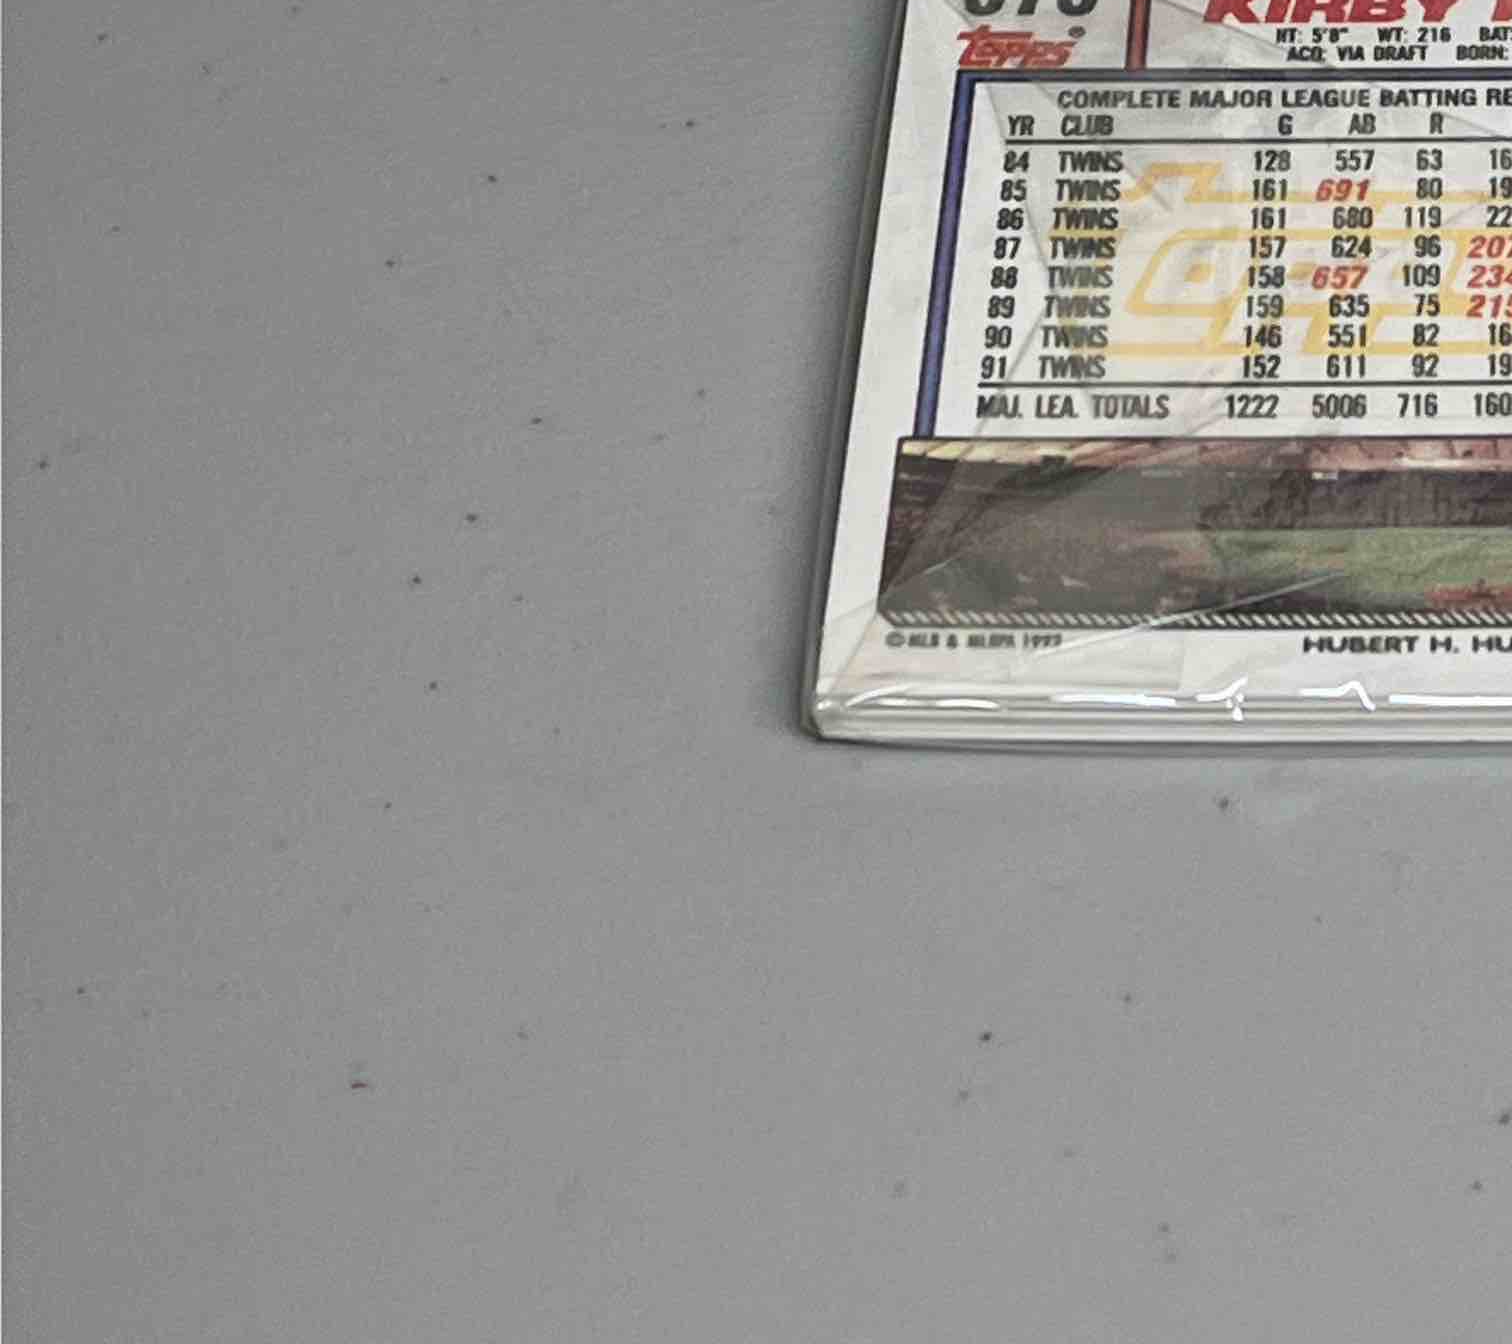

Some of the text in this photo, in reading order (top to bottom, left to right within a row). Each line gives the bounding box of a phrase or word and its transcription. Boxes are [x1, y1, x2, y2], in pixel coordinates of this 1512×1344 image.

[957, 23, 1077, 67] Topps
[1276, 27, 1303, 43] HT:
[1378, 27, 1408, 43] WT:
[1418, 27, 1451, 42] 216
[1287, 46, 1326, 62] ACQ:
[1337, 46, 1365, 61] VIA
[1373, 45, 1429, 62] DRAFT
[1456, 44, 1509, 61] BORN:
[1057, 90, 1181, 109] COMPLETE
[1189, 89, 1272, 108] MAJOR
[1281, 88, 1371, 107] LEAGUE
[1379, 88, 1477, 108] BATTING
[1008, 115, 1035, 136] YR
[1061, 114, 1114, 137] CLUB
[1278, 113, 1293, 136] G
[1348, 113, 1376, 135] AB
[1430, 111, 1445, 134] R
[1060, 150, 1125, 173] TWINS
[1254, 149, 1291, 172] 128
[1335, 149, 1375, 172] 557
[1416, 148, 1443, 171] 63
[1315, 179, 1370, 202] 691
[993, 236, 1022, 260] 87
[1049, 236, 1116, 260] TWINS
[1248, 234, 1287, 259] 157
[1331, 234, 1372, 261] 624
[1414, 234, 1442, 258] 96
[1311, 265, 1366, 289] 657
[981, 355, 1007, 381] 91
[1038, 355, 1105, 379] TWINS
[1243, 354, 1281, 379] 152
[1326, 353, 1366, 379] 611
[1411, 352, 1439, 378] 92
[1035, 394, 1079, 419] LEA.
[1091, 394, 1170, 419] TOTALS
[1224, 394, 1279, 419] 1222
[1312, 393, 1367, 419] 5006
[1397, 392, 1438, 418] 716
[1303, 634, 1419, 654] HUBERT
[1429, 635, 1460, 654] H.
